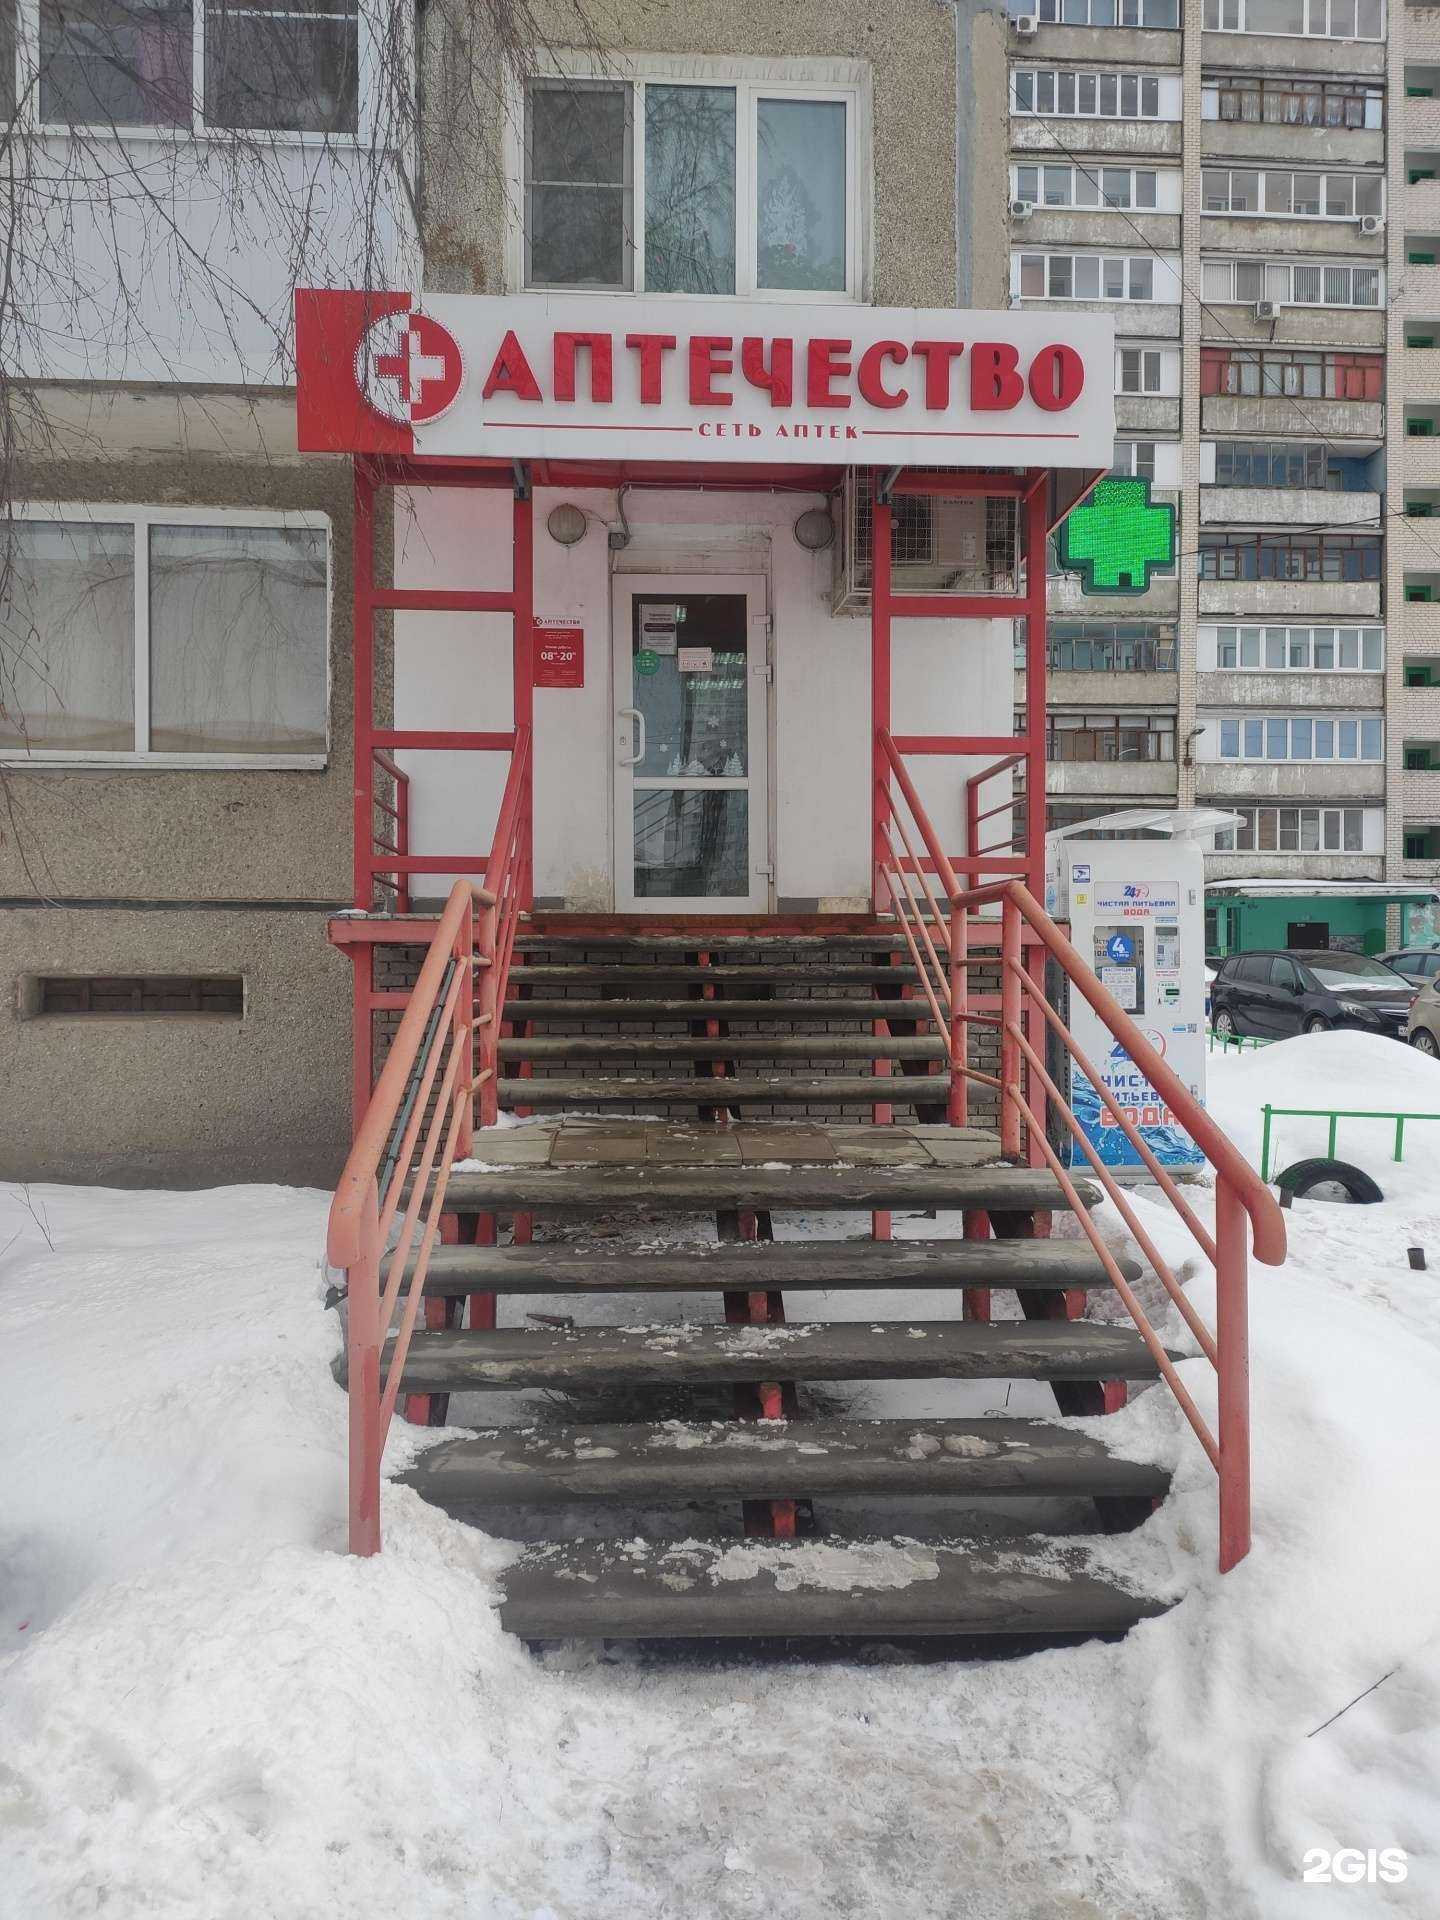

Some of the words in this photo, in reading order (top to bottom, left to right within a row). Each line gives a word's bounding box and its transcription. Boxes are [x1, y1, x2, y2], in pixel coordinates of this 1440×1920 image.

[482, 330, 1084, 412] АПТЕЧЕСТВО
[698, 423, 762, 437] СЕТЬ
[776, 424, 857, 439] АПТЕК
[1123, 908, 1150, 916] ВОДА
[1101, 1075, 1150, 1087] ЧИСТ
[1111, 1092, 1160, 1101] ИТЬЕВ
